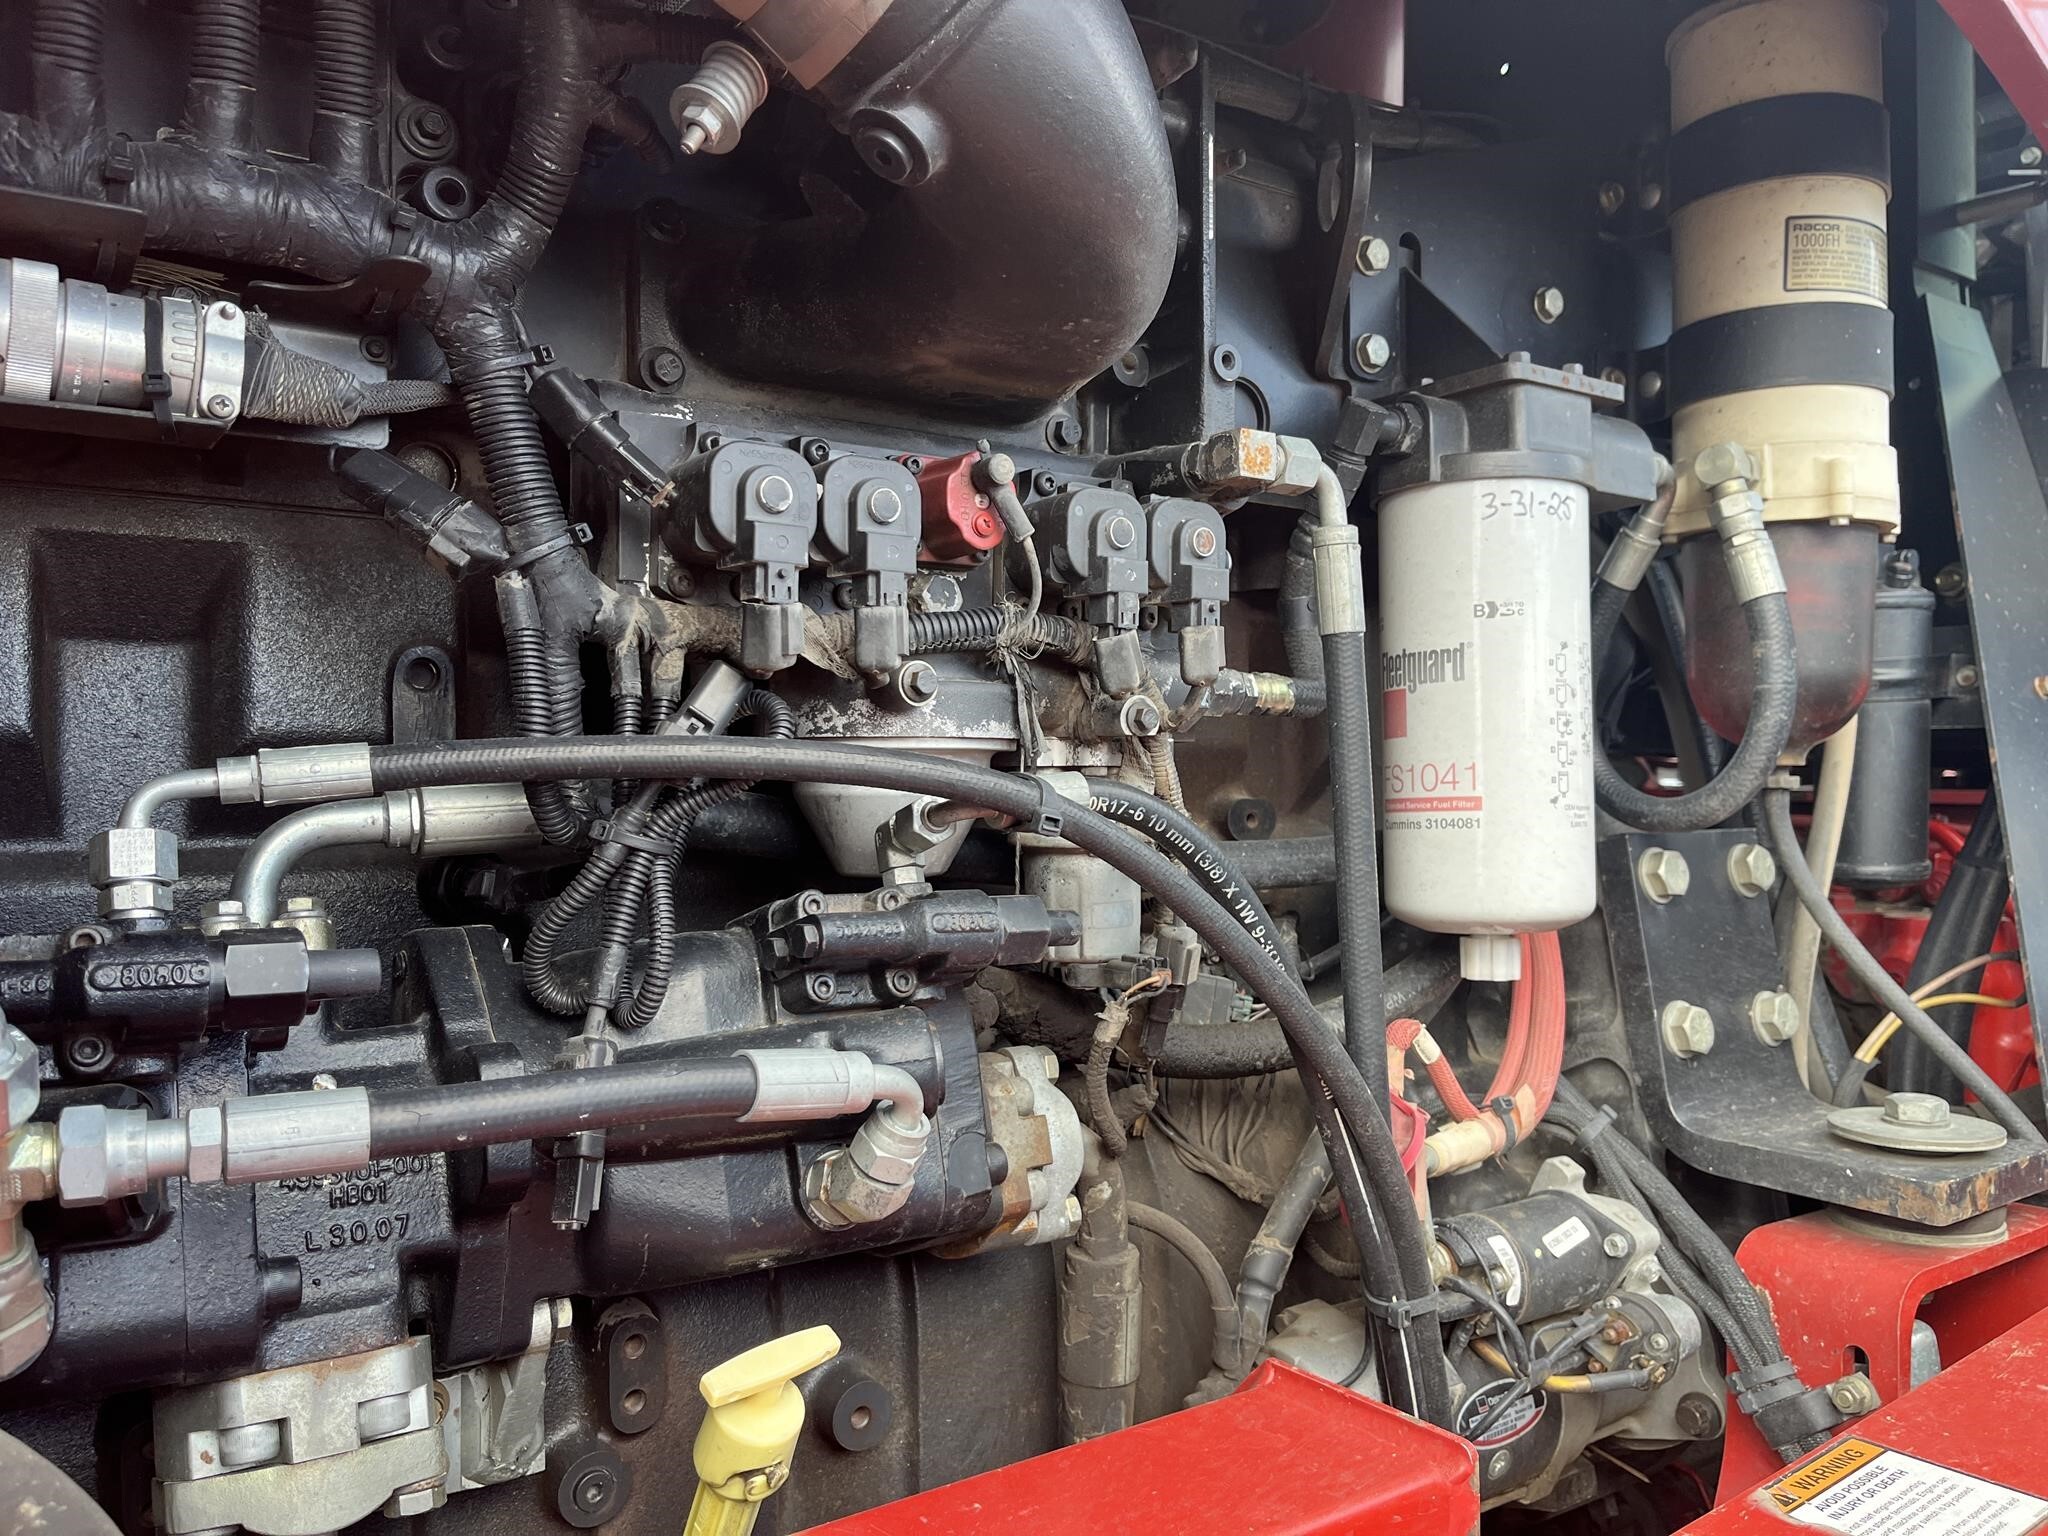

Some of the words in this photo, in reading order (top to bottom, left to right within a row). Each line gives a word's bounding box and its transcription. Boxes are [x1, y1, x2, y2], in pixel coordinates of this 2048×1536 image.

[1793, 233, 1840, 248] 1000FH
[1481, 489, 1576, 521] 3-31-25
[1406, 801, 1431, 809] Service
[1453, 800, 1475, 808] Filter
[1425, 817, 1481, 830] 3104081
[1148, 813, 1167, 832] 10
[1165, 827, 1196, 855] mm
[1193, 849, 1229, 884] (3/8)
[1221, 881, 1240, 899] X
[1790, 1448, 1865, 1490] WARNING
[1815, 1492, 1847, 1512] AVOID
[1841, 1465, 1889, 1494] POSSIBLE
[1827, 1497, 1866, 1520] INJURY
[1861, 1486, 1881, 1499] OR
[1874, 1469, 1909, 1490] DEATH
